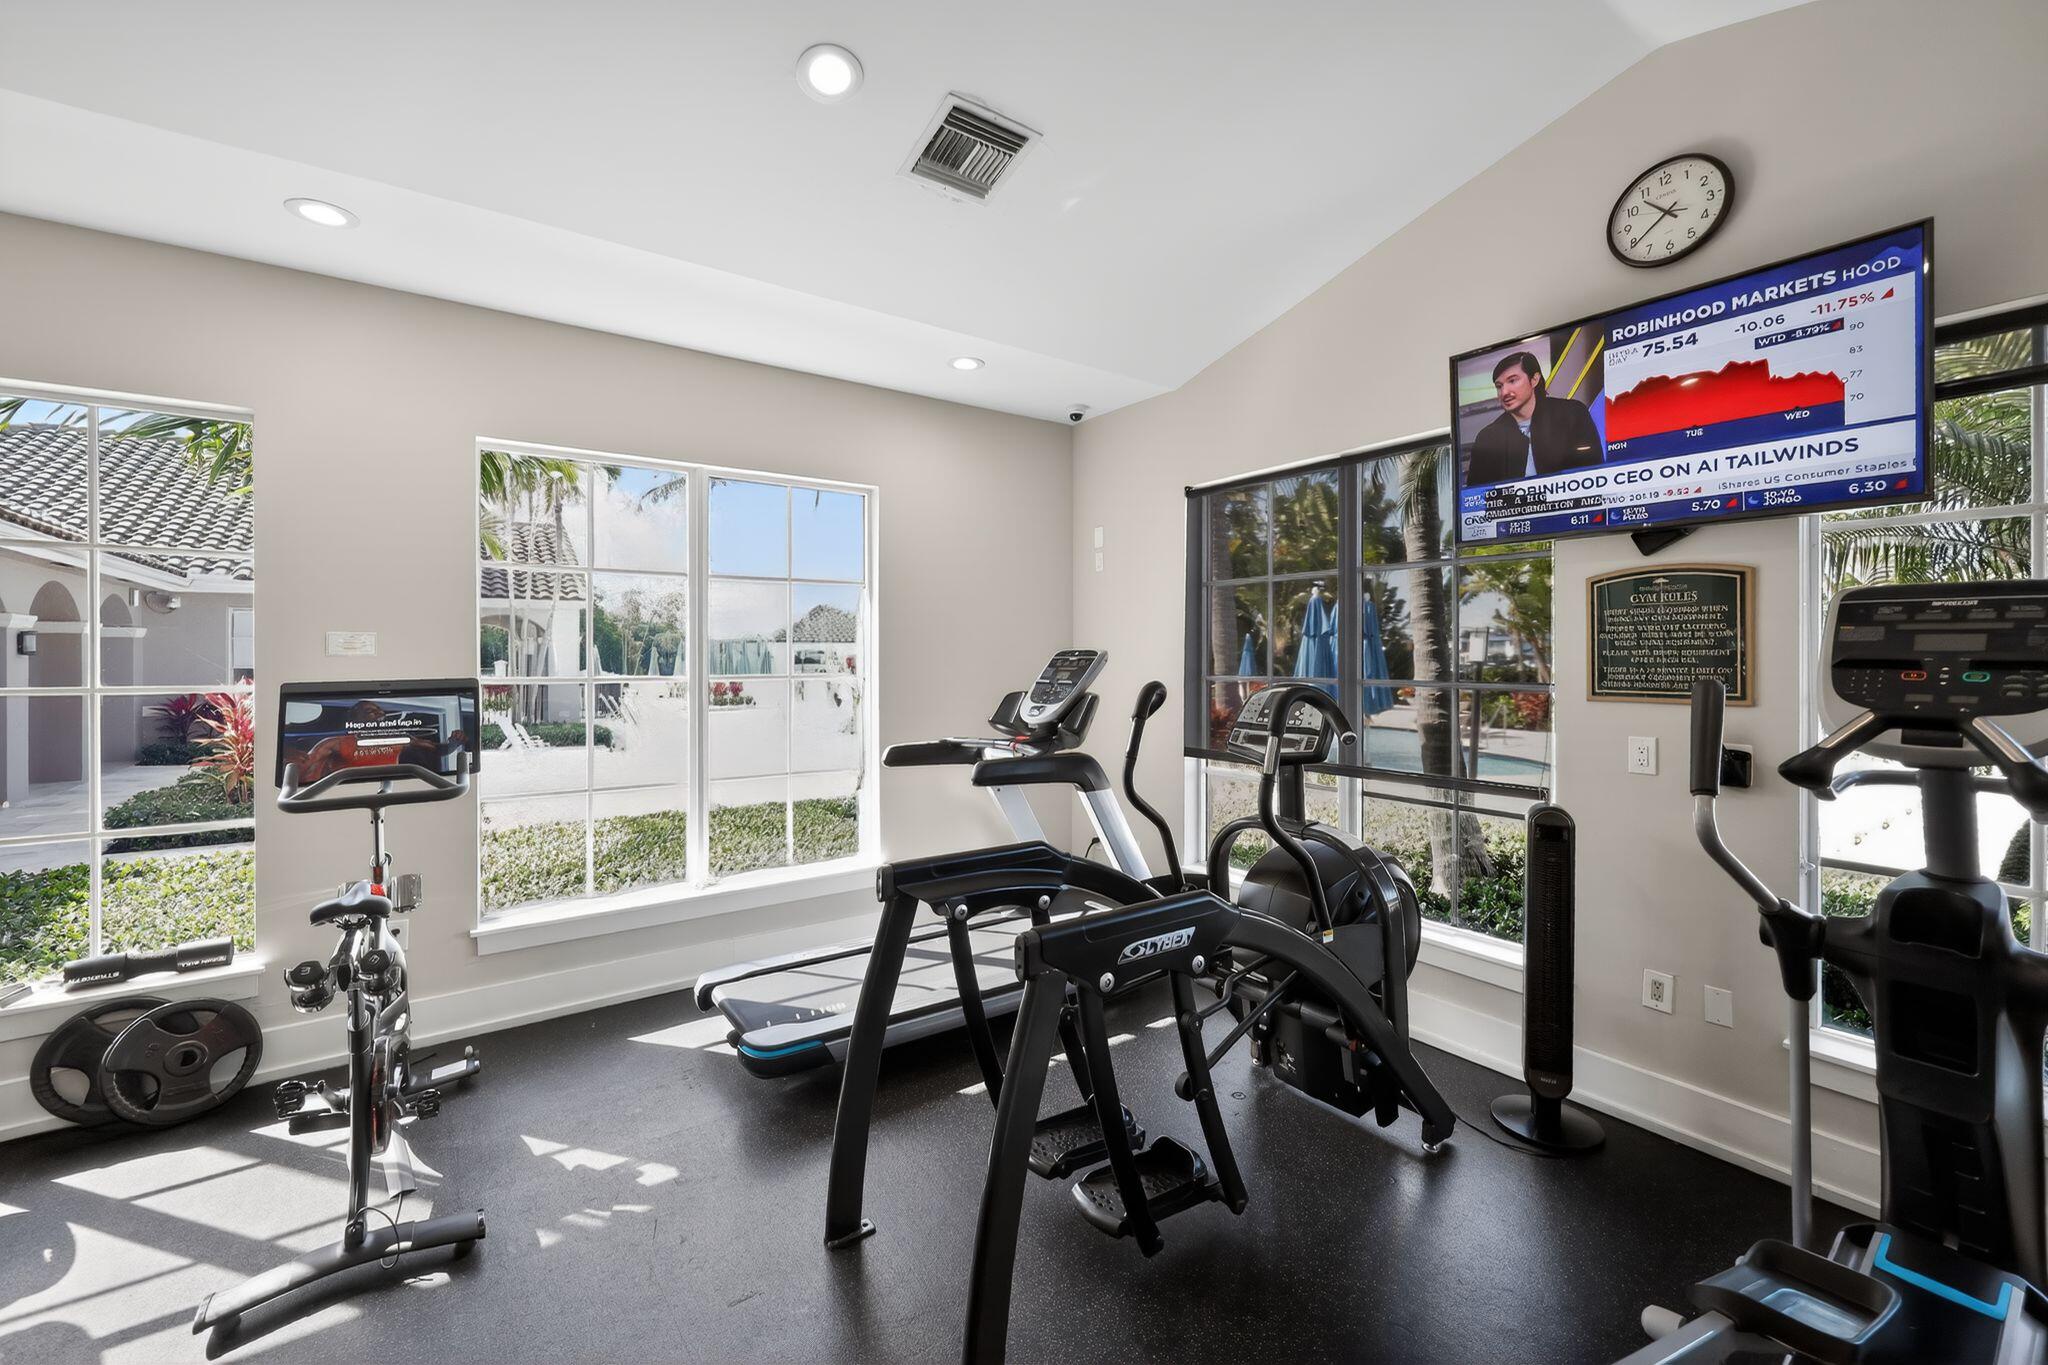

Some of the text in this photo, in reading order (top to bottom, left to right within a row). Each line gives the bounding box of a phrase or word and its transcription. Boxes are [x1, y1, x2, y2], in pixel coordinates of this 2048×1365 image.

[1659, 173, 1672, 186] 12
[1700, 175, 1709, 187] 2
[1641, 187, 1650, 199] 11
[1706, 190, 1715, 201] 3
[1627, 206, 1639, 218] 10
[1701, 208, 1709, 219] 4
[1624, 224, 1632, 235] 9
[1687, 227, 1696, 239] 5
[1646, 243, 1653, 255] 7
[1666, 240, 1674, 251] 6
[1612, 256, 1901, 343] ROBINHOOD MARKETS HOOD
[1734, 291, 1875, 334] -10.06 -11.75%
[1642, 332, 1699, 358] 75.54
[1758, 333, 1786, 346] WTD
[1850, 369, 1863, 378] 77
[1850, 393, 1864, 402] 70
[1784, 410, 1810, 420] WED
[1613, 468, 1653, 485] CEO
[1660, 462, 1690, 479] ON
[1697, 458, 1718, 474] AI
[1725, 437, 1859, 469] TAILWINDS
[1764, 475, 1780, 485] US
[1784, 467, 1850, 482] Consumer
[1855, 459, 1908, 474] Staples
[1849, 480, 1887, 494] 6.30
[1691, 499, 1721, 512] 5.70
[1570, 514, 1589, 525] 6.11
